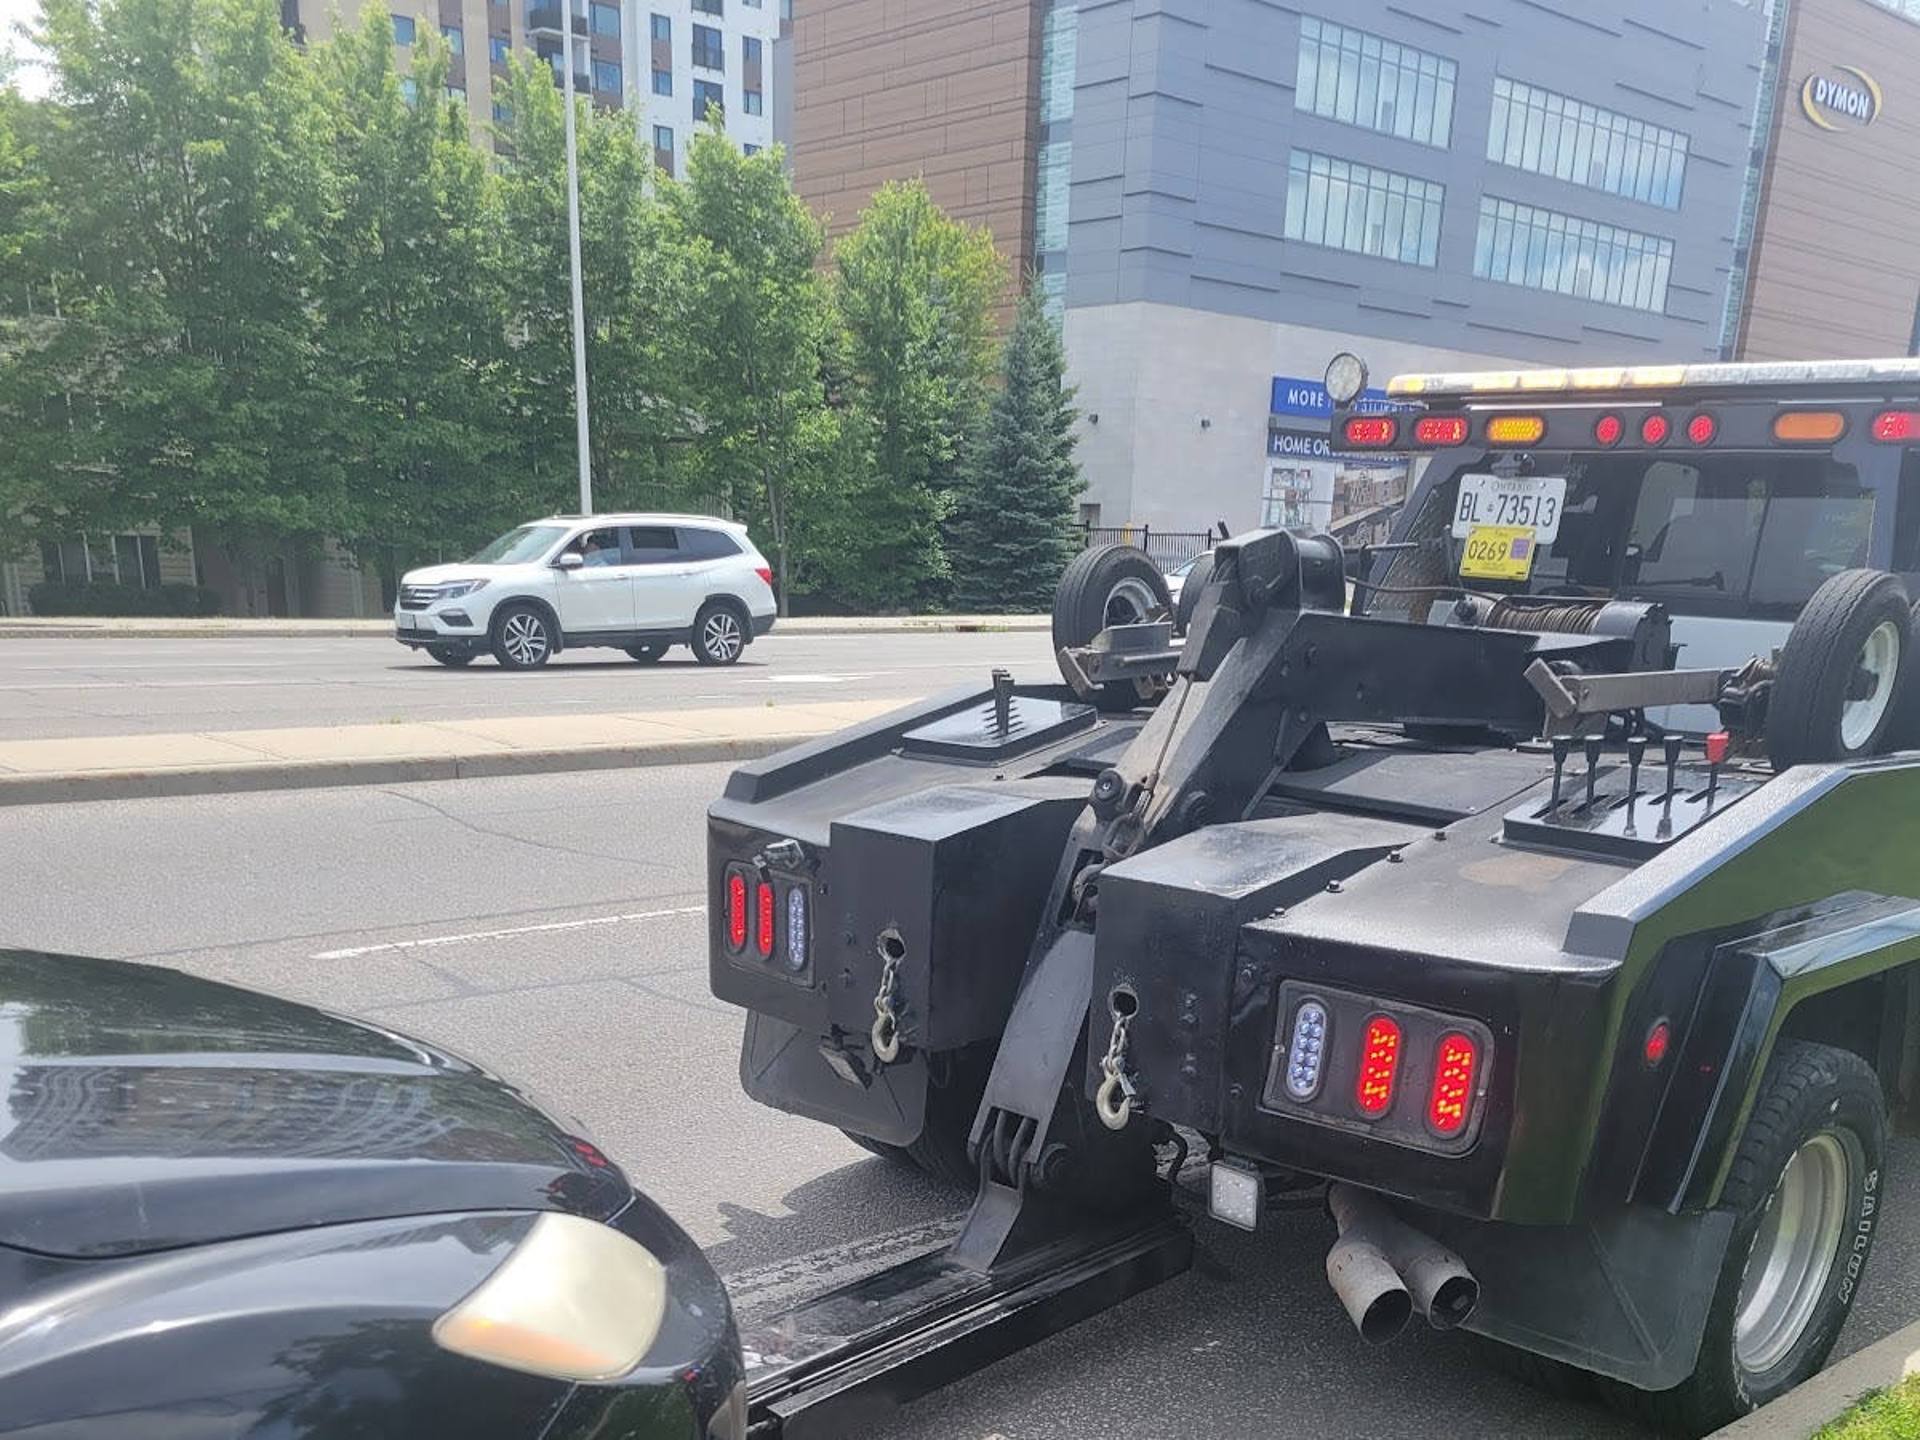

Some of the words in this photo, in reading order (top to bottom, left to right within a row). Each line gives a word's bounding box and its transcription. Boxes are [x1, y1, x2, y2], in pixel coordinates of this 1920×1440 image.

[1815, 77, 1870, 118] DYMON
[1287, 388, 1324, 407] MORE
[1273, 435, 1311, 454] HOME
[1458, 492, 1481, 523] BL
[1495, 494, 1556, 527] 73513
[1468, 540, 1508, 561] 0269
